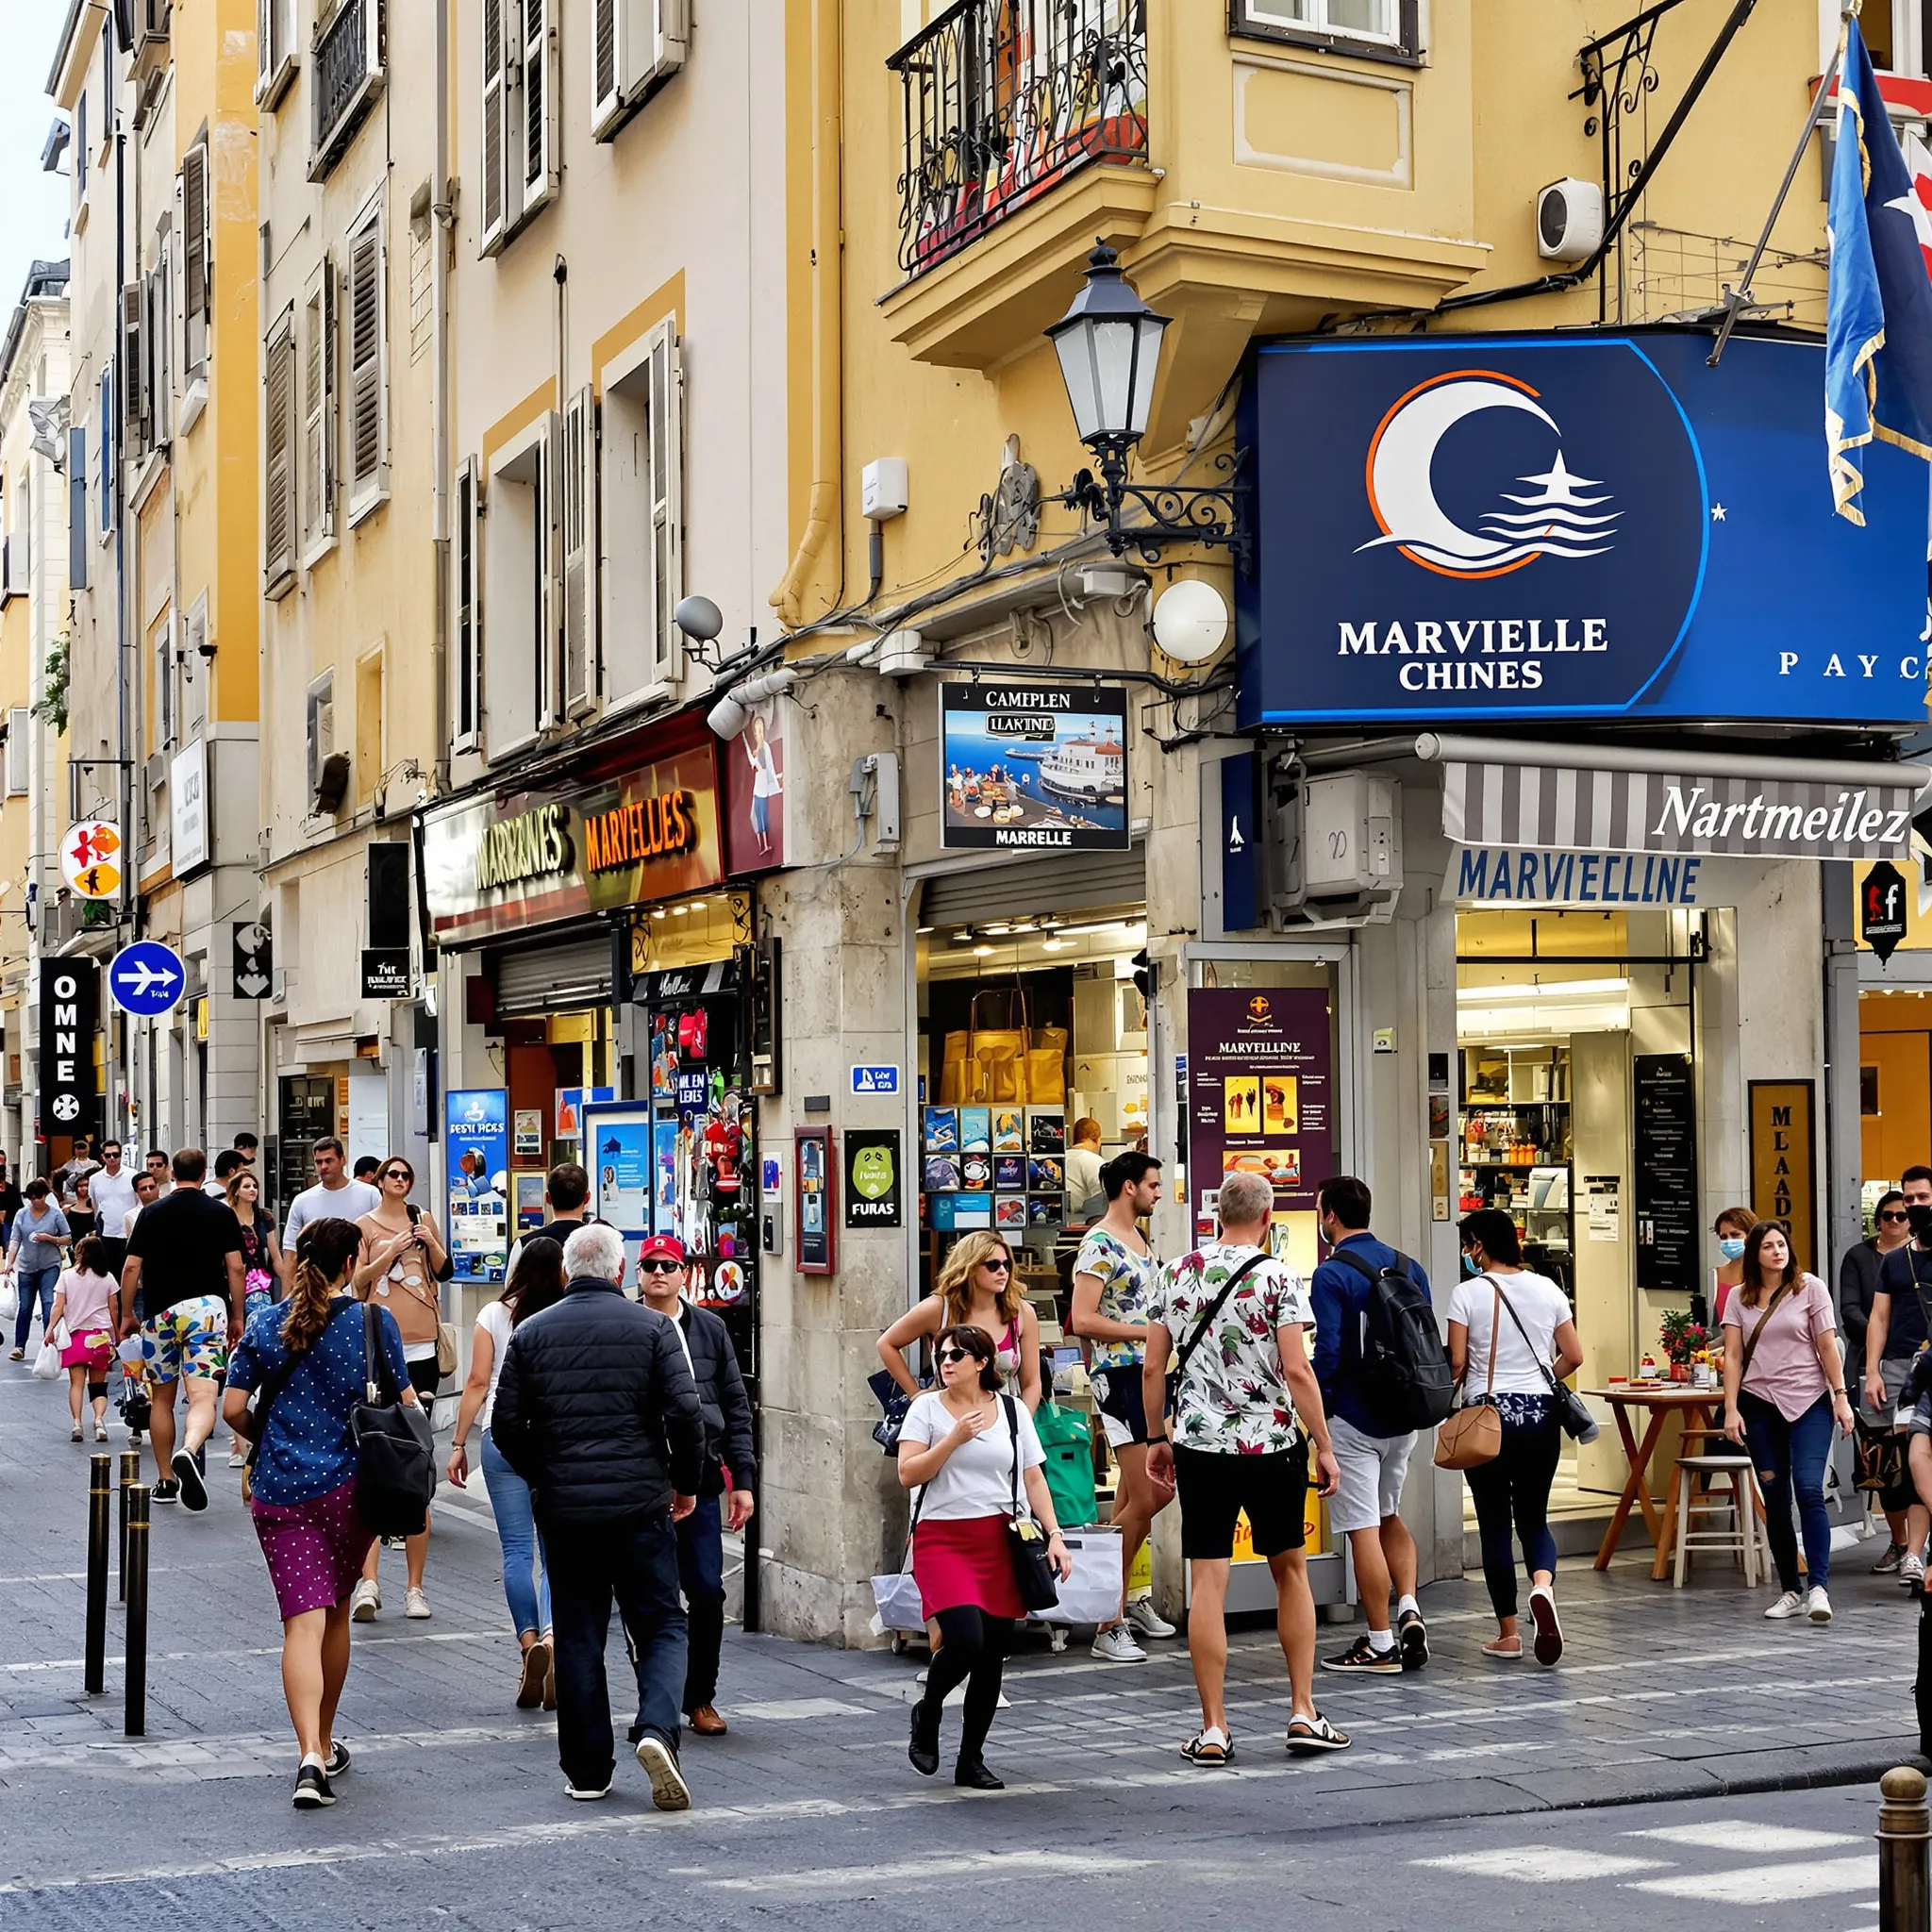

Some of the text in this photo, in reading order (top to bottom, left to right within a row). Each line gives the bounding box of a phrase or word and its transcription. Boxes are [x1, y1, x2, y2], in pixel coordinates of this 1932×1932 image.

[1338, 619, 1608, 655] MARVIELLE
[1399, 660, 1543, 691] CHINES
[1778, 651, 1928, 680] PAYC
[1651, 786, 1910, 843] Nartmeilez
[996, 830, 1073, 845] MARRELLE
[54, 975, 77, 1082] OMNE
[852, 1203, 895, 1216] FURAS
